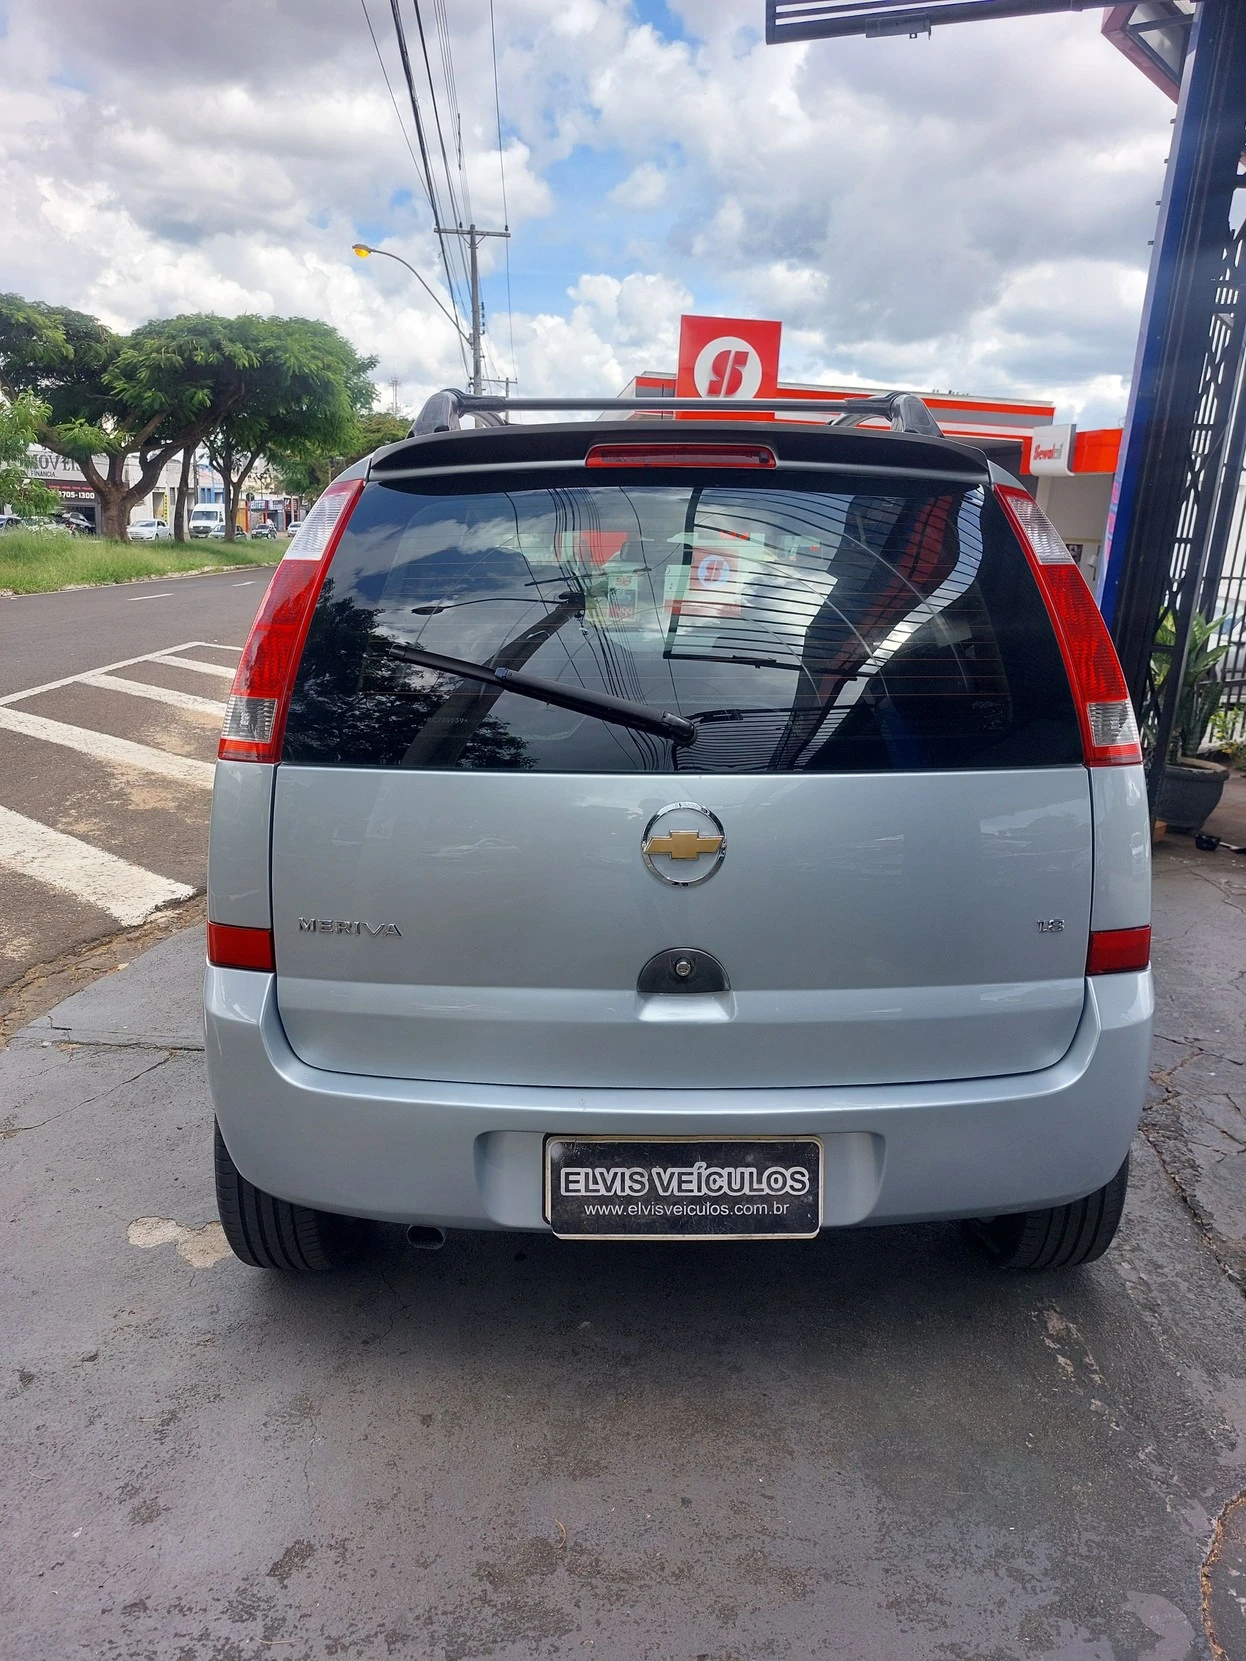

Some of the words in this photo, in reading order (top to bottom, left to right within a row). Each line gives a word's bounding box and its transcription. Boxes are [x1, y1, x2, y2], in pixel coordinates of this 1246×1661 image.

[298, 917, 404, 937] MERIVA
[561, 1168, 648, 1196] ELVIS
[651, 1162, 810, 1196] VEÍCULOS
[584, 1202, 789, 1216] www.elvisveiculos.com.br
